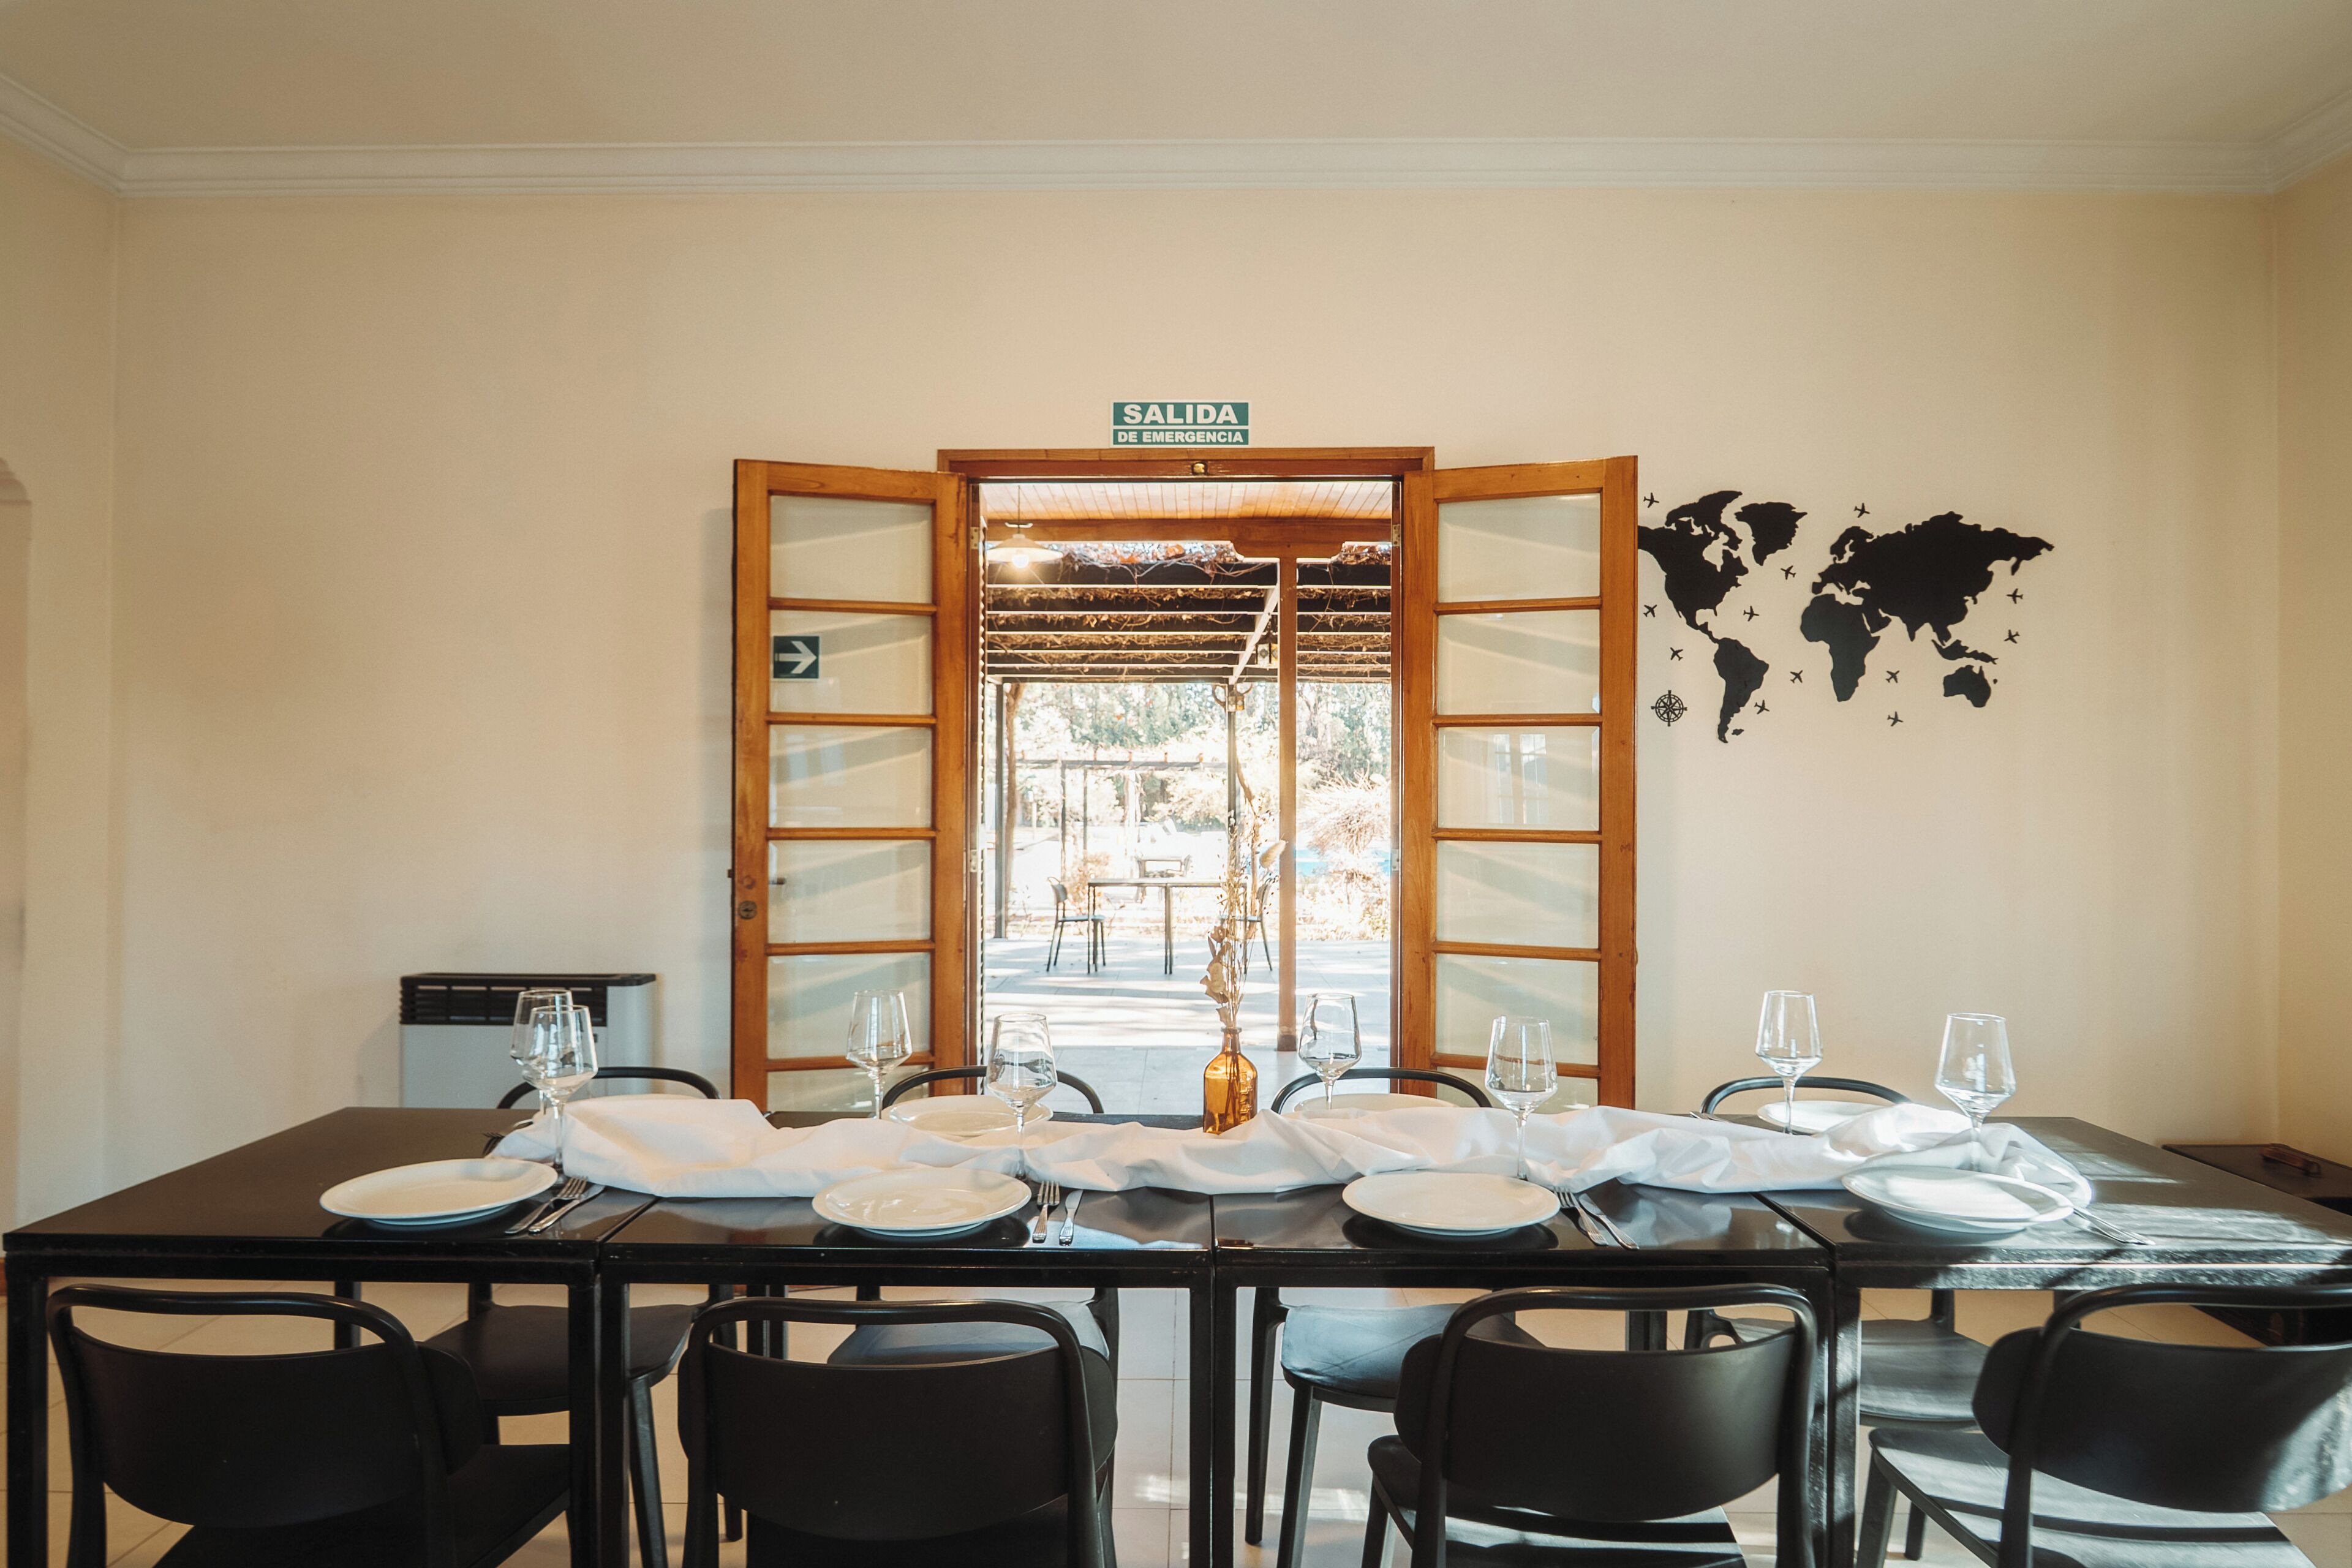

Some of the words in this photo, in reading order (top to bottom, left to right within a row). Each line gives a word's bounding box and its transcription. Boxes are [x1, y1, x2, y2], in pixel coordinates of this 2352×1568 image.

[1123, 404, 1238, 424] SALIDA
[1118, 431, 1137, 443] DE
[1142, 431, 1243, 443] EMERGENCIA
